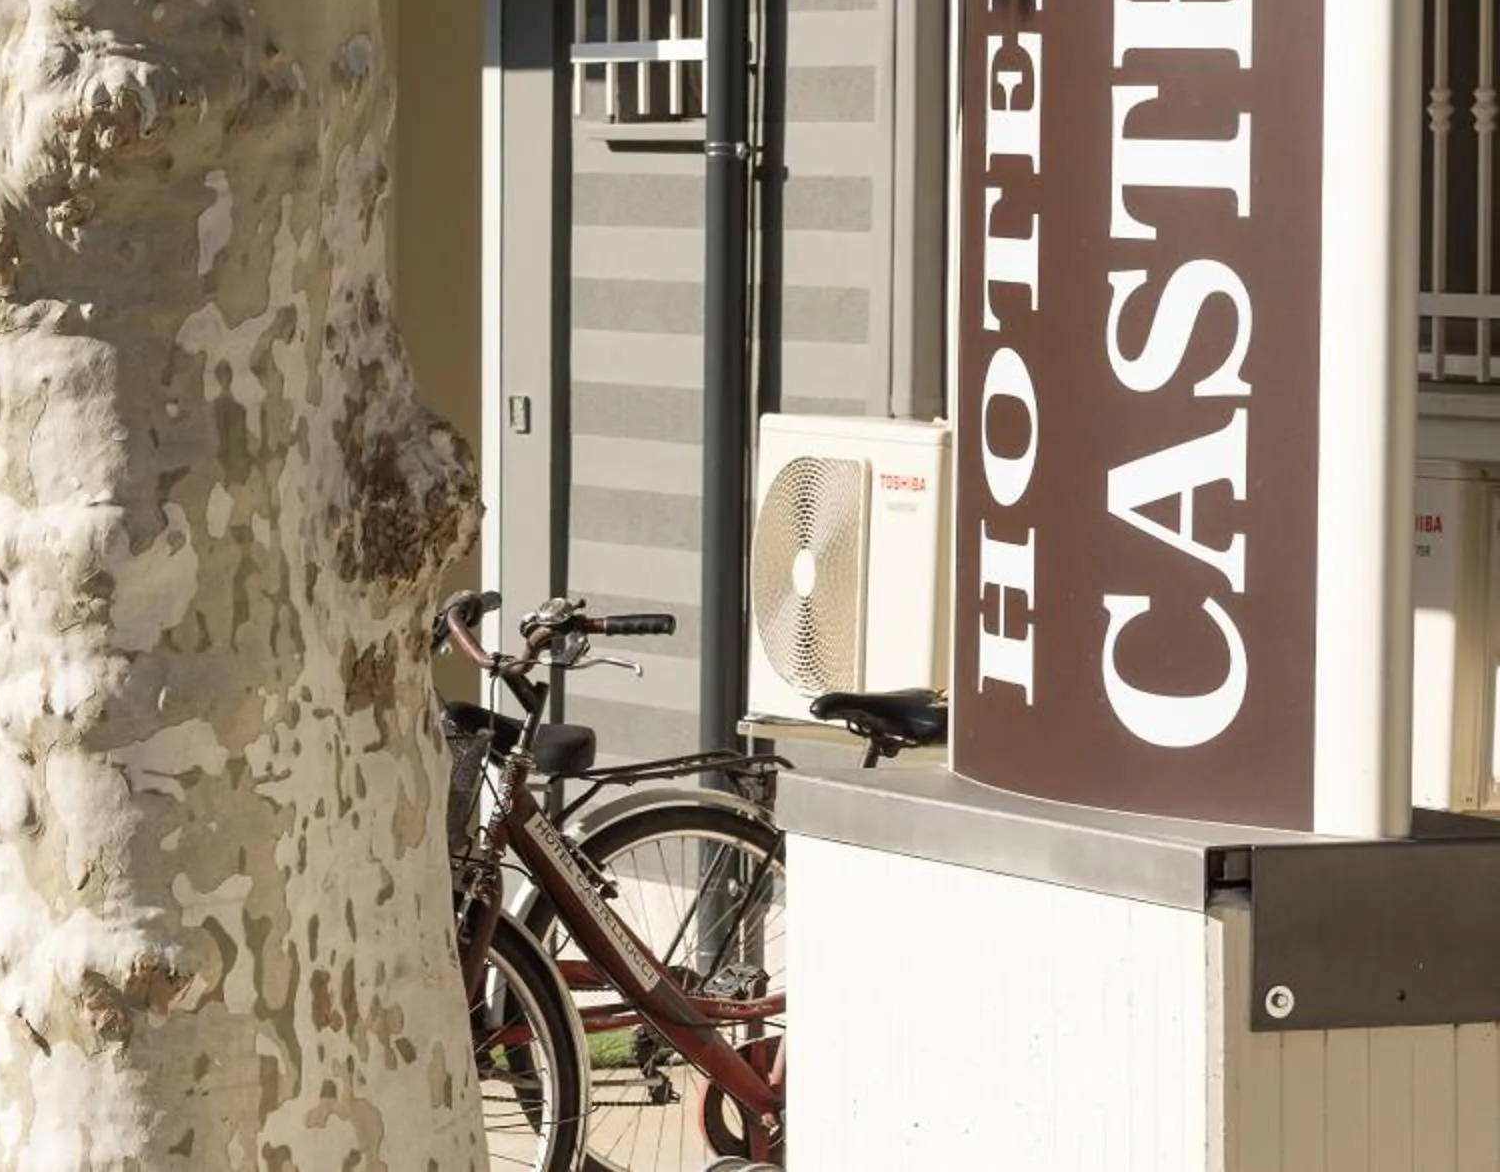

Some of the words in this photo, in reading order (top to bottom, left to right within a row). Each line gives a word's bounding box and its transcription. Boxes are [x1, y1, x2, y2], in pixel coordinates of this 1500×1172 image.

[880, 473, 926, 492] TOSHIBA
[534, 818, 575, 874] HOTEL
[577, 874, 656, 981] CASTELLUCCI
